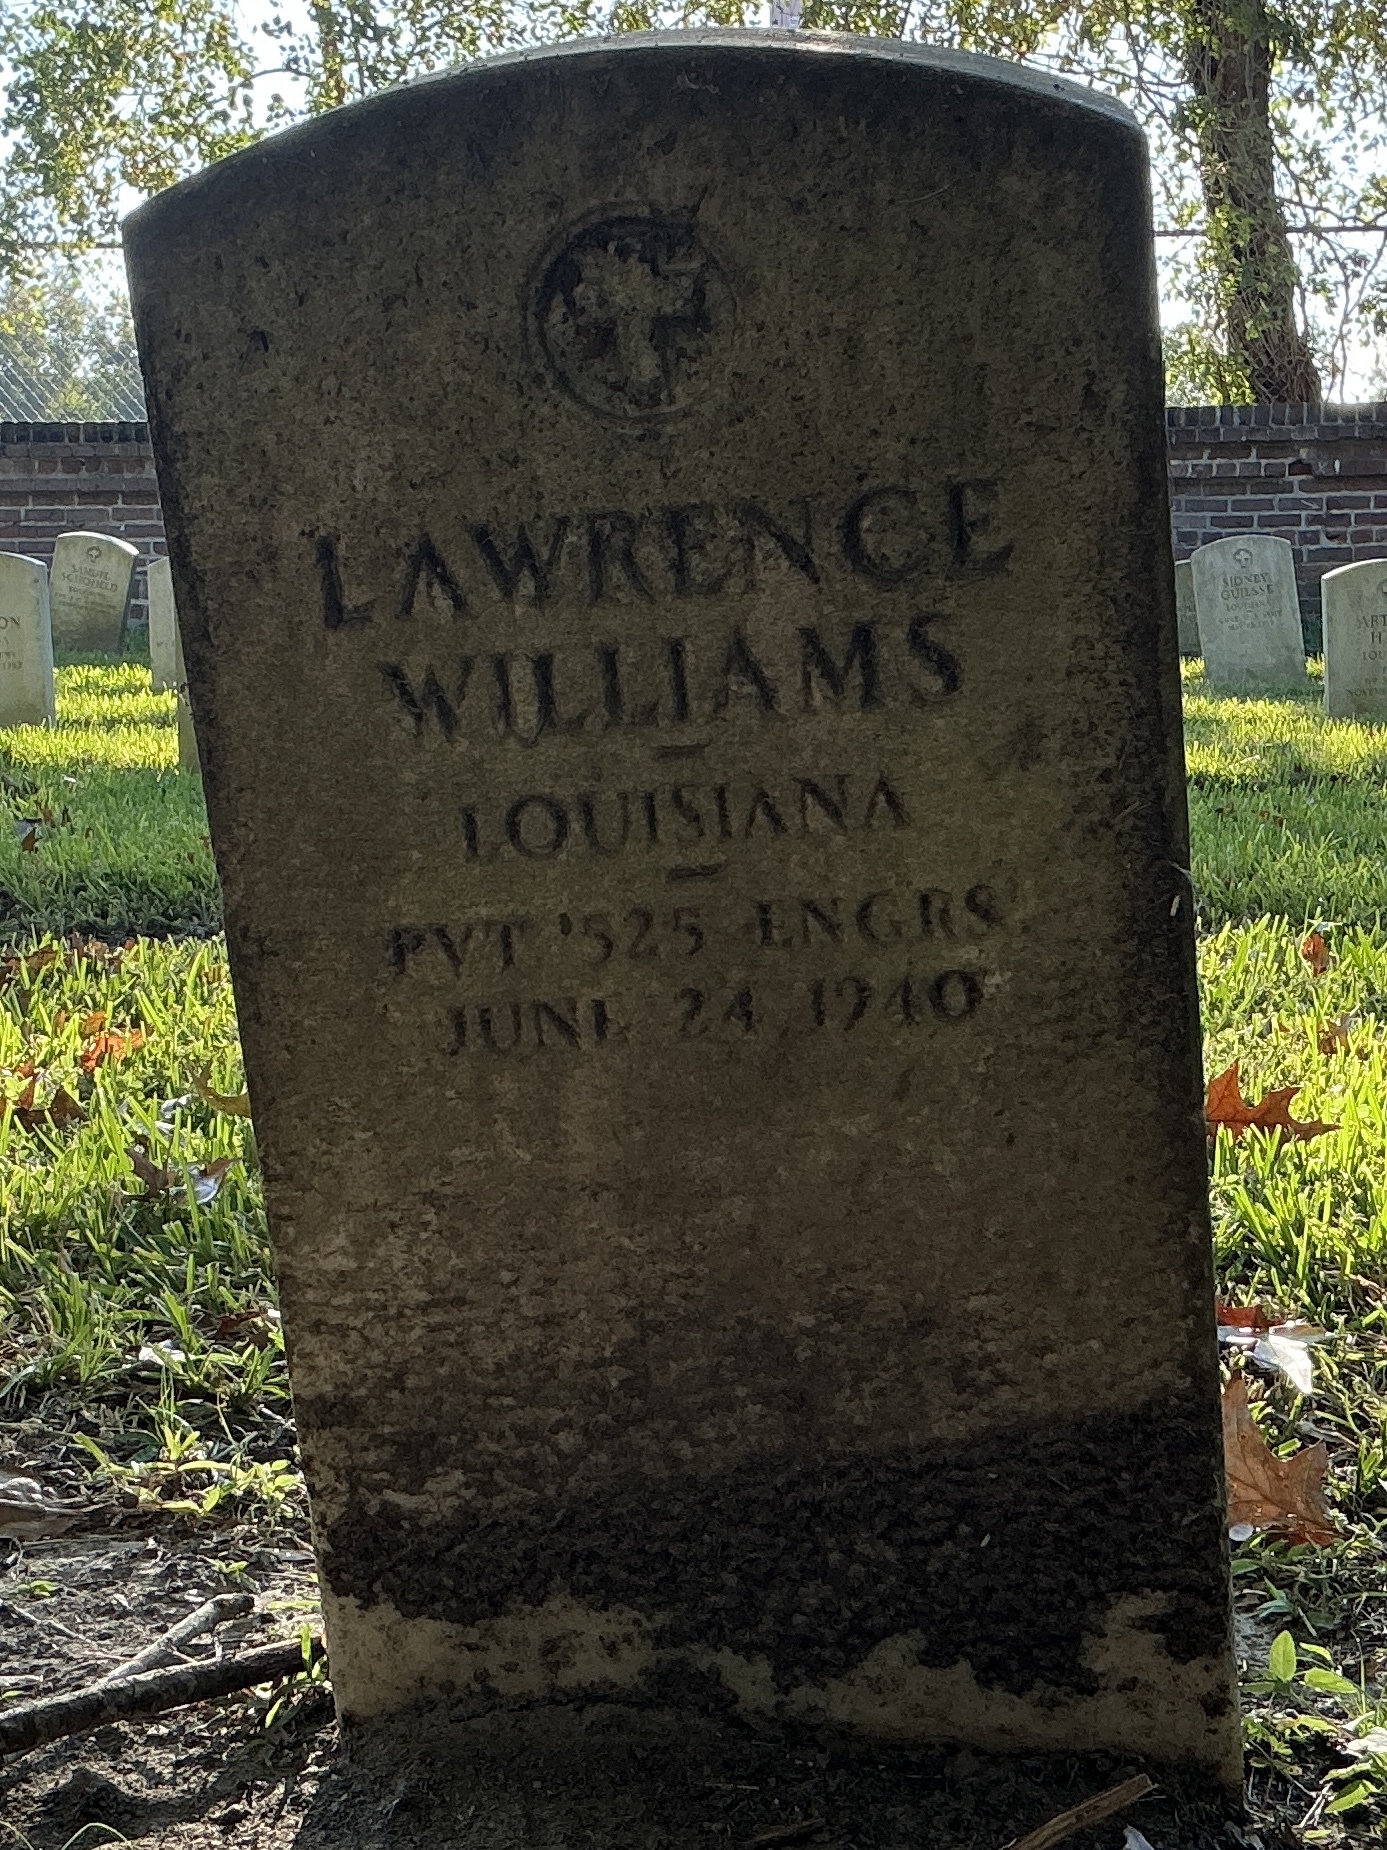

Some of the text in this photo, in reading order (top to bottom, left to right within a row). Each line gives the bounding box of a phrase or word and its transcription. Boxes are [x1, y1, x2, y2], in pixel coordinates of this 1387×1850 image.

[313, 478, 1014, 630] LAWRENCE
[378, 613, 964, 744] WILLIAMS
[460, 772, 912, 862] LOUISIANA
[386, 917, 530, 977] PVT
[440, 968, 985, 1058] JUNE 24 1940
